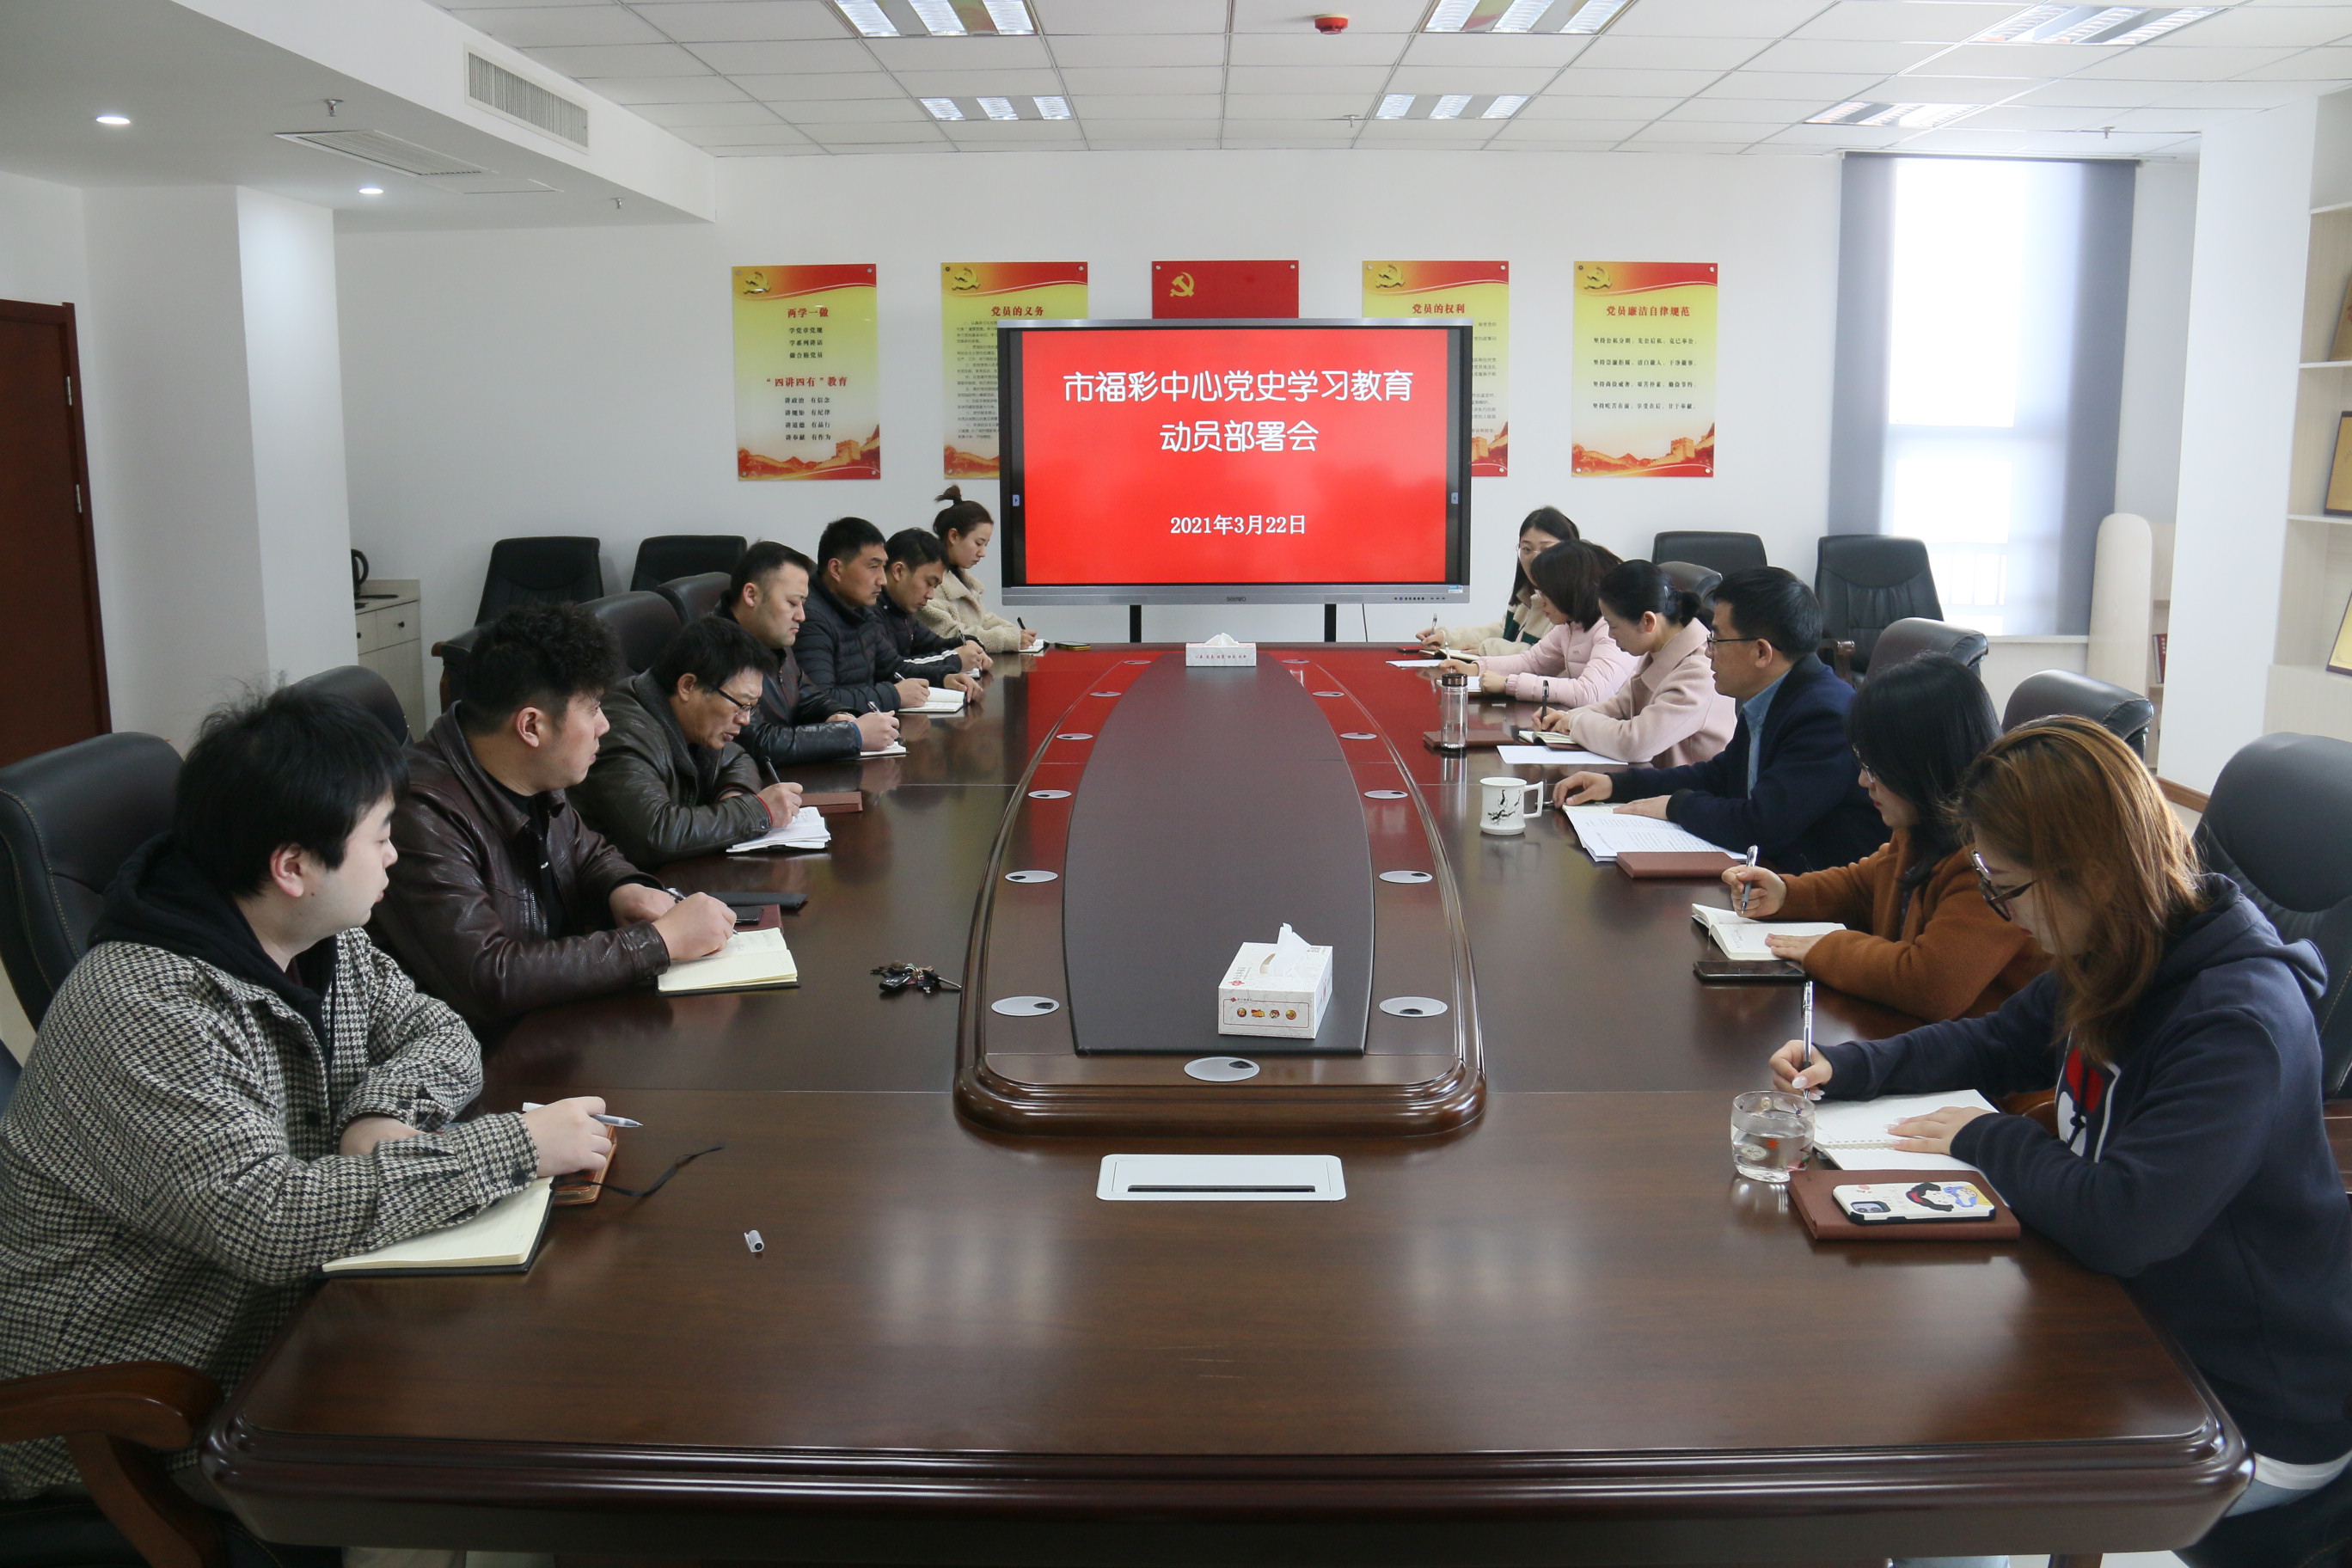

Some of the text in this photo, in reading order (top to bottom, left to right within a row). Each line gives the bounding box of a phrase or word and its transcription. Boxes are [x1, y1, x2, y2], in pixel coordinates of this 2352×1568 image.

[787, 307, 829, 319] 两学一做
[990, 305, 1044, 317] 党员的义务
[1412, 303, 1465, 315] 党员的权利
[1606, 305, 1690, 317] 党员廉洁自律规范
[1063, 369, 1414, 402] 市福彩中心党史学习教育
[1159, 419, 1320, 453] 动员部署会
[1170, 514, 1307, 536] 2021年3月22日
